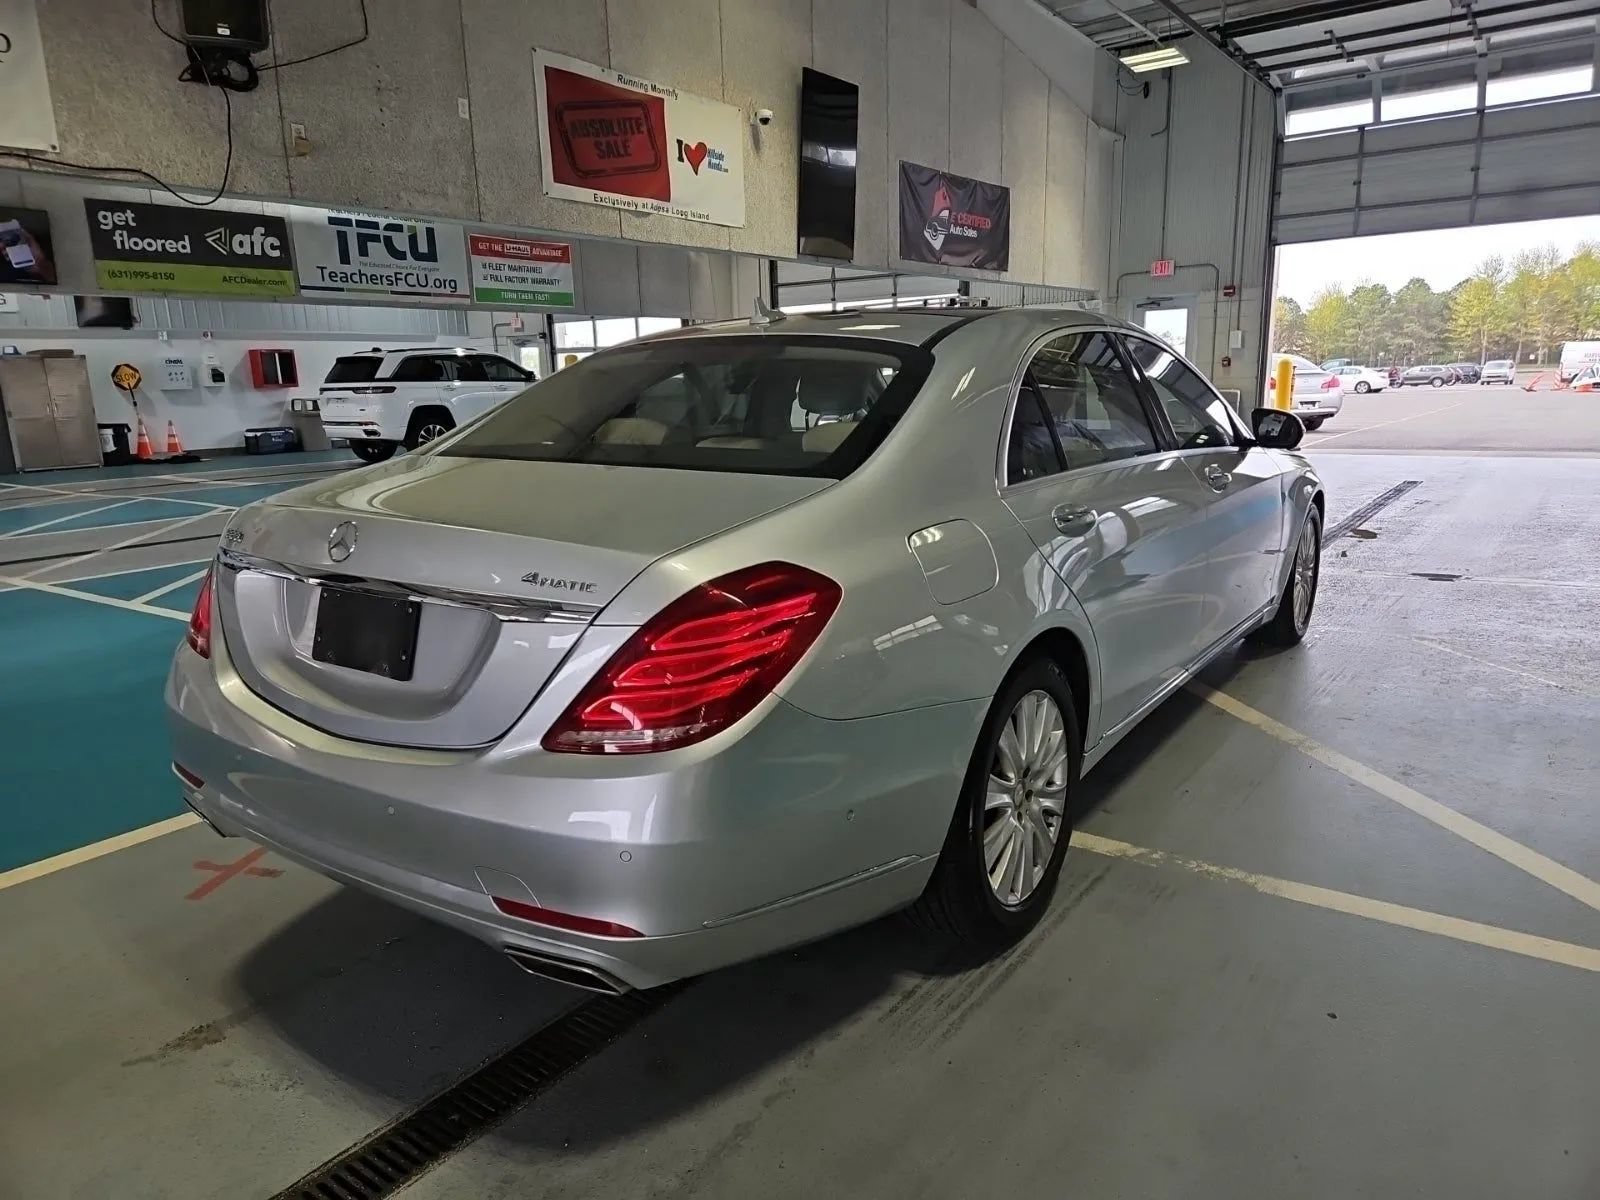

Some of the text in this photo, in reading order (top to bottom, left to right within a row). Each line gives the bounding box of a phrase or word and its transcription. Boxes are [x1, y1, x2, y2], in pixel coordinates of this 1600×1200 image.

[617, 74, 679, 100] Running Monthly
[569, 117, 645, 139] ABSOLUTE
[593, 138, 632, 160] SALE
[676, 138, 684, 163] I
[593, 193, 638, 209] Exclusively
[690, 210, 710, 220] Island
[98, 209, 136, 230] get
[950, 224, 963, 235] Auto
[113, 230, 191, 254] floored
[232, 227, 281, 257] afc
[327, 216, 438, 265] TFCU
[478, 242, 491, 250] GET
[492, 244, 503, 252] THE
[489, 262, 543, 274] FLEET MAINTAINED
[1154, 261, 1171, 275] EXIT
[316, 266, 458, 293] TeachersFCU.org
[490, 274, 503, 283] FULL
[505, 275, 531, 285] FACTORY
[500, 291, 517, 300] TURN
[115, 372, 137, 383] SLOW
[520, 572, 597, 593] 4MATIC
